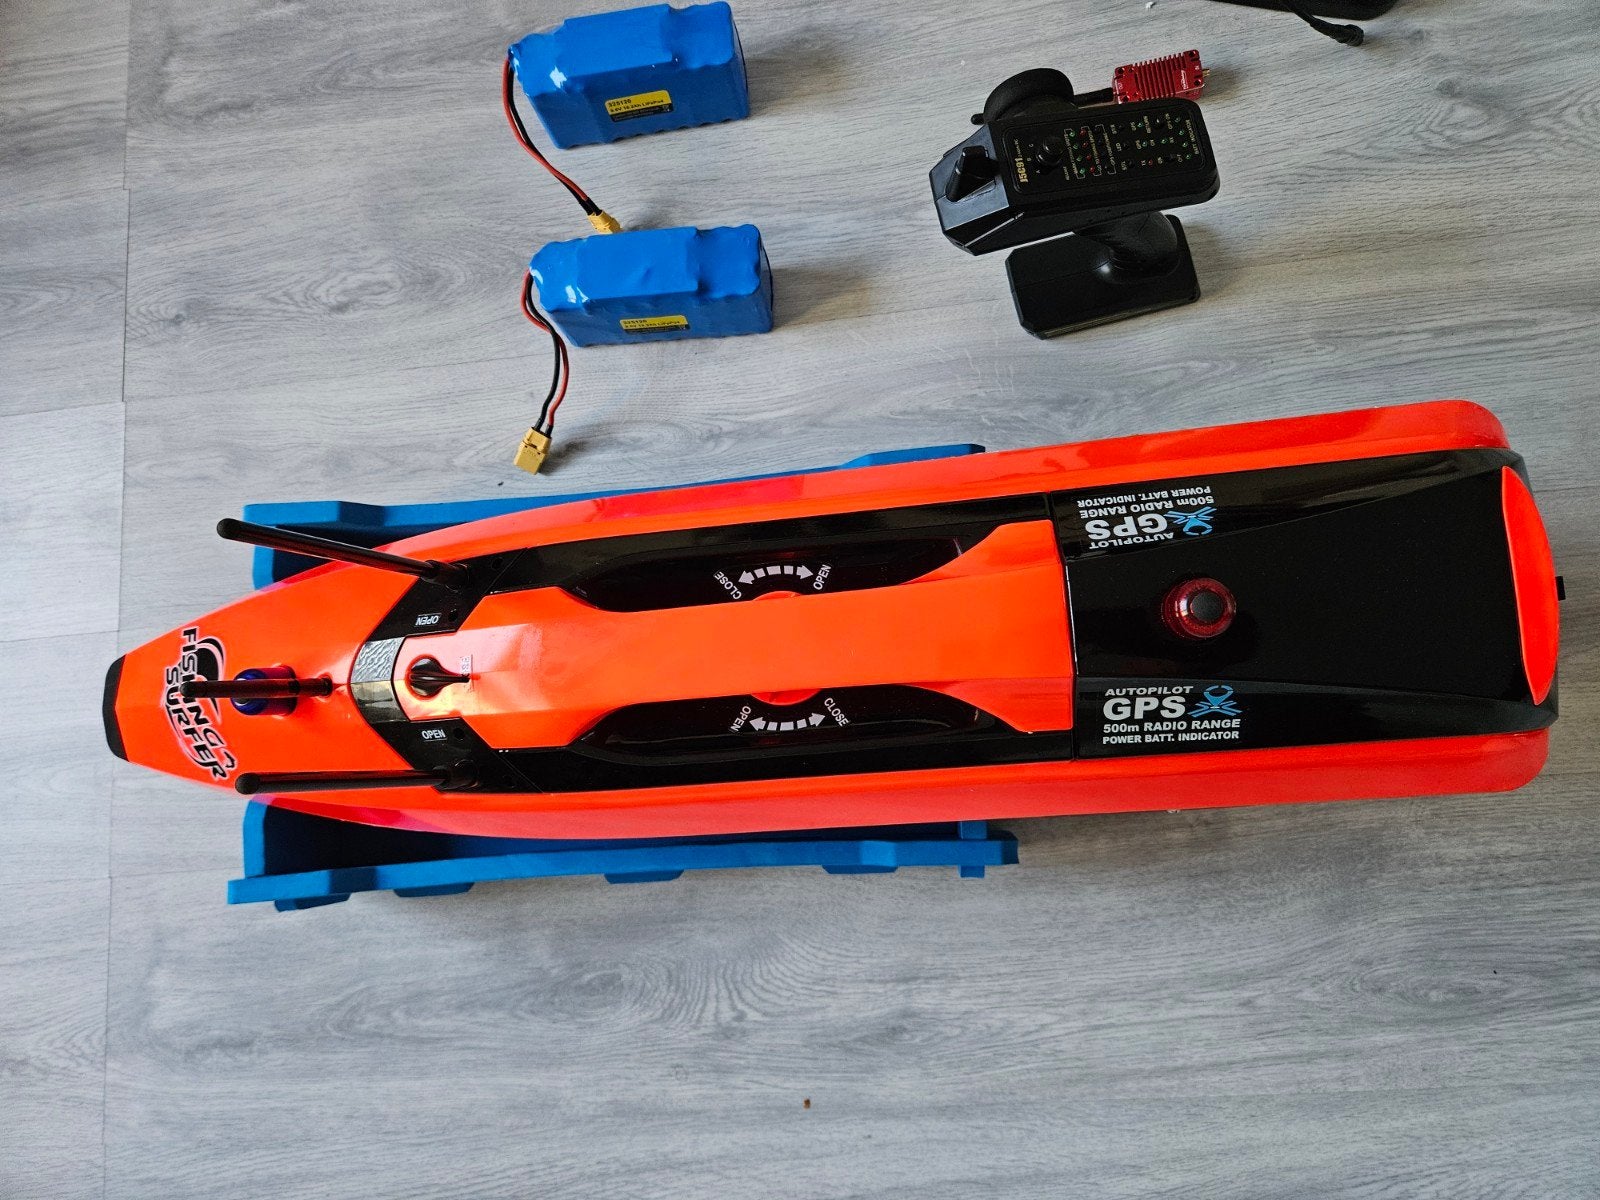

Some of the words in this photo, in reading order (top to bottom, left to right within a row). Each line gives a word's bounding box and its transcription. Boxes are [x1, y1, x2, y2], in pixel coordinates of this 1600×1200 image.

[1014, 157, 1029, 183] J5C91
[1138, 491, 1169, 501] BATT.
[1171, 486, 1212, 498] POWER
[1077, 494, 1136, 508] INDICATOR
[1130, 500, 1174, 513] RADIO
[1177, 495, 1215, 506] 500m
[1079, 505, 1128, 519] RANGE
[1085, 513, 1168, 540] GPS
[1089, 532, 1174, 550] AUTOPILOT
[812, 564, 832, 590] OPEN
[714, 571, 742, 600] CLOSE
[415, 615, 440, 626] OPEN
[1104, 685, 1194, 697] AUTOPILOT
[823, 697, 850, 727] CLOSE
[1103, 695, 1186, 721] GPS
[166, 667, 227, 778] SURFER
[729, 705, 752, 732] OPEN
[1103, 723, 1140, 734] 500m
[1143, 720, 1188, 732] RADIO
[1191, 718, 1241, 730] RANGE
[421, 729, 446, 740] OPEN
[1102, 734, 1142, 745] POWER
[1144, 733, 1175, 743] BATT.
[1178, 730, 1240, 742] INDICATOR
